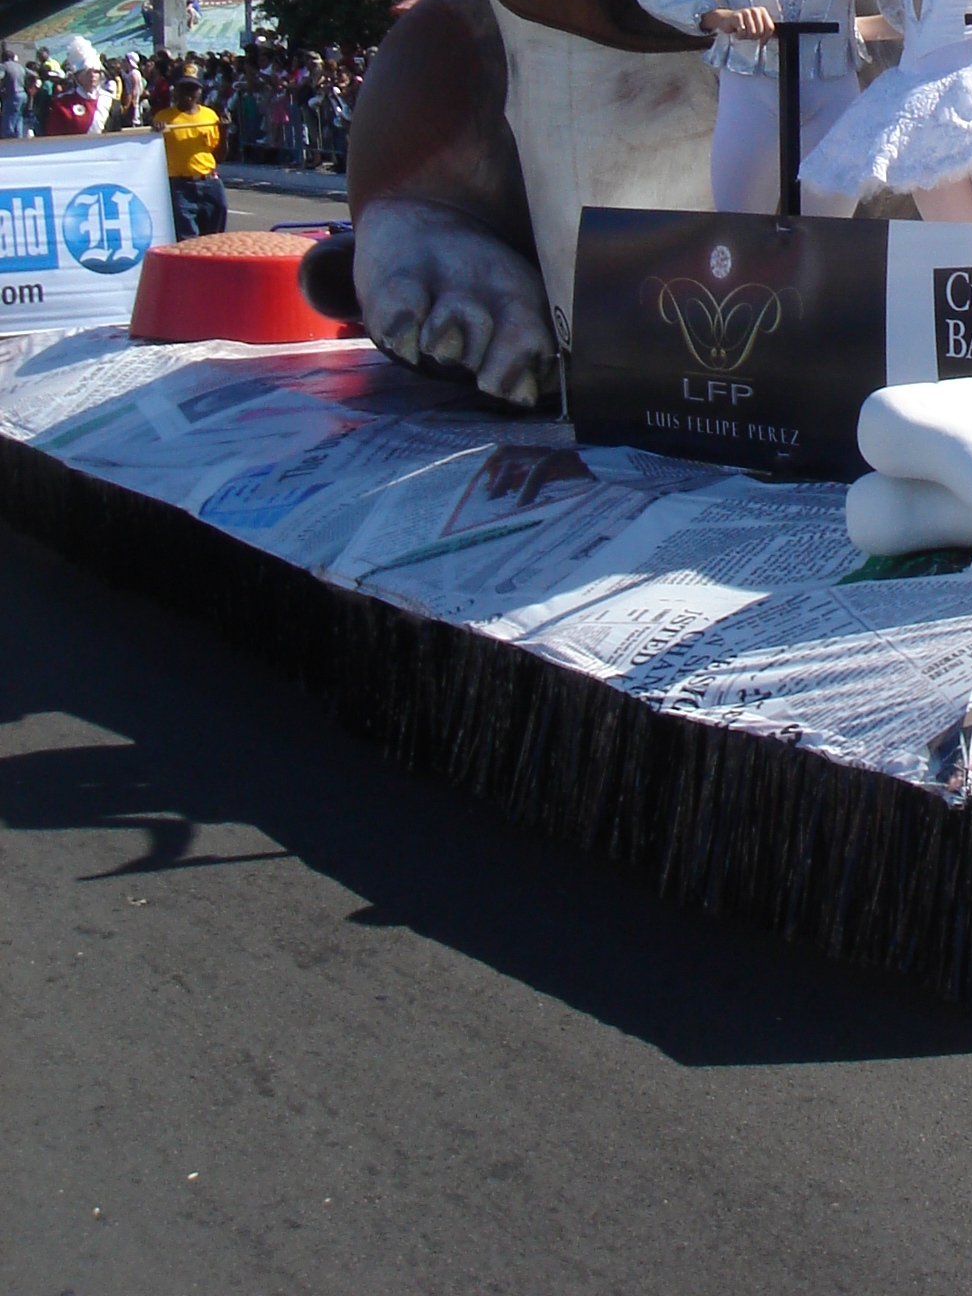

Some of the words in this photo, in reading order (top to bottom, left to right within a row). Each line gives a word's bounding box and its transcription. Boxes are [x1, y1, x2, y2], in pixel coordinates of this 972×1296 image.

[682, 377, 754, 405] LFP
[646, 410, 680, 430] LUIS
[687, 415, 740, 438] FELIPE
[747, 423, 800, 447] PEREZ
